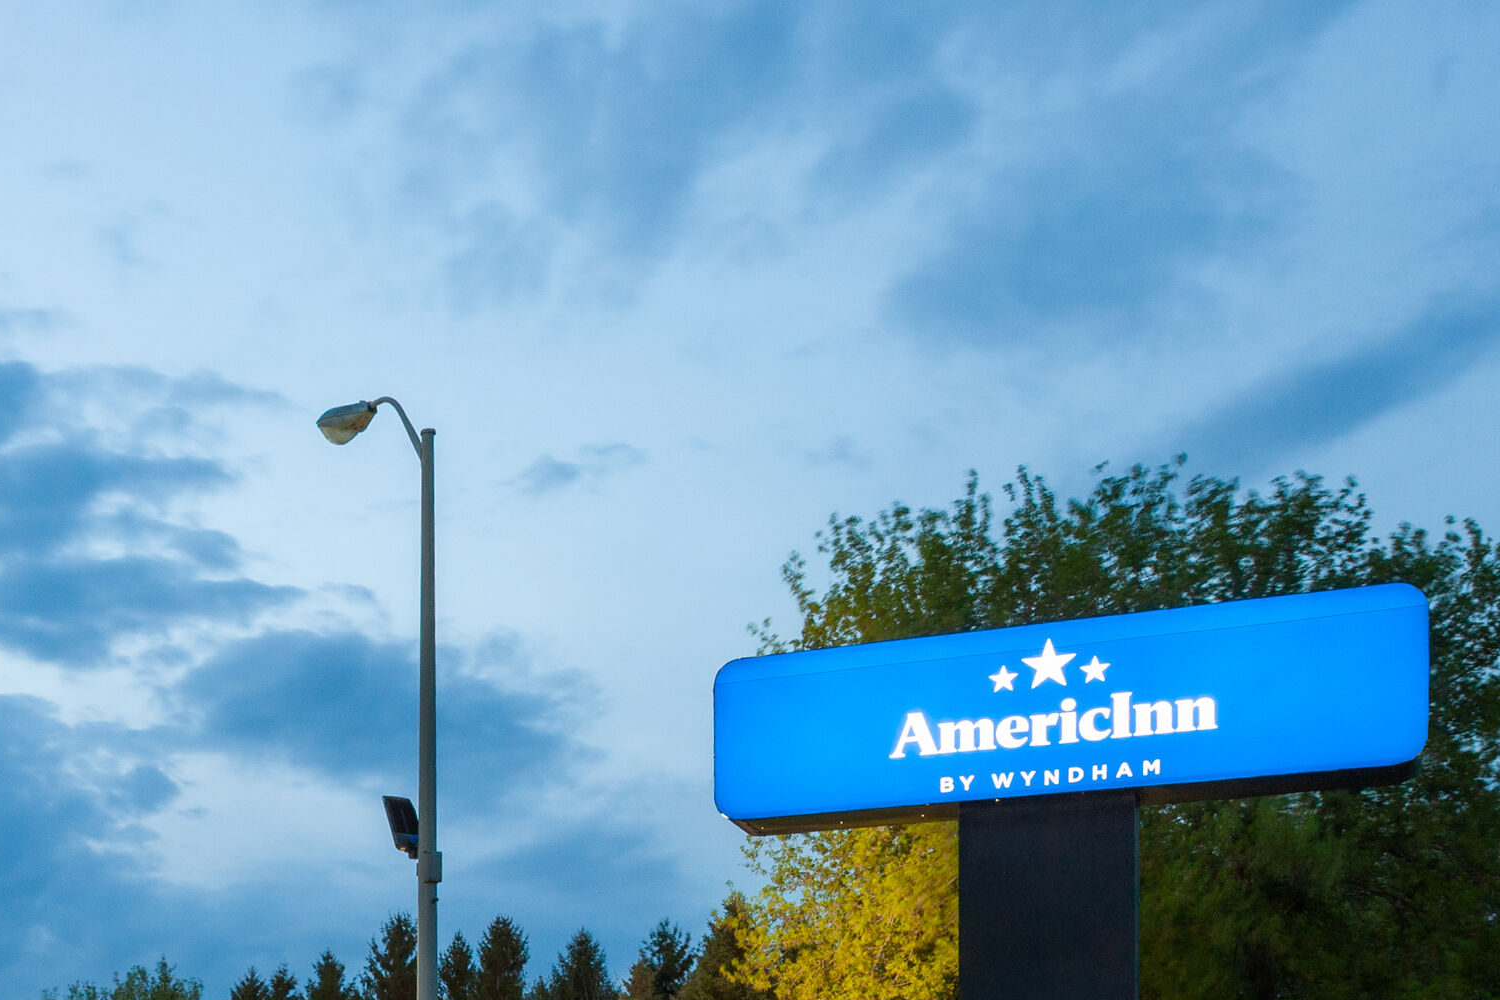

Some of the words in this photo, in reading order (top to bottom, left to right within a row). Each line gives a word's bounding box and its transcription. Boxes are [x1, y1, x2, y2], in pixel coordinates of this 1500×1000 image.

[889, 691, 1218, 760] AmericInn
[939, 774, 975, 794] BY
[991, 758, 1161, 790] WYNDHAM
